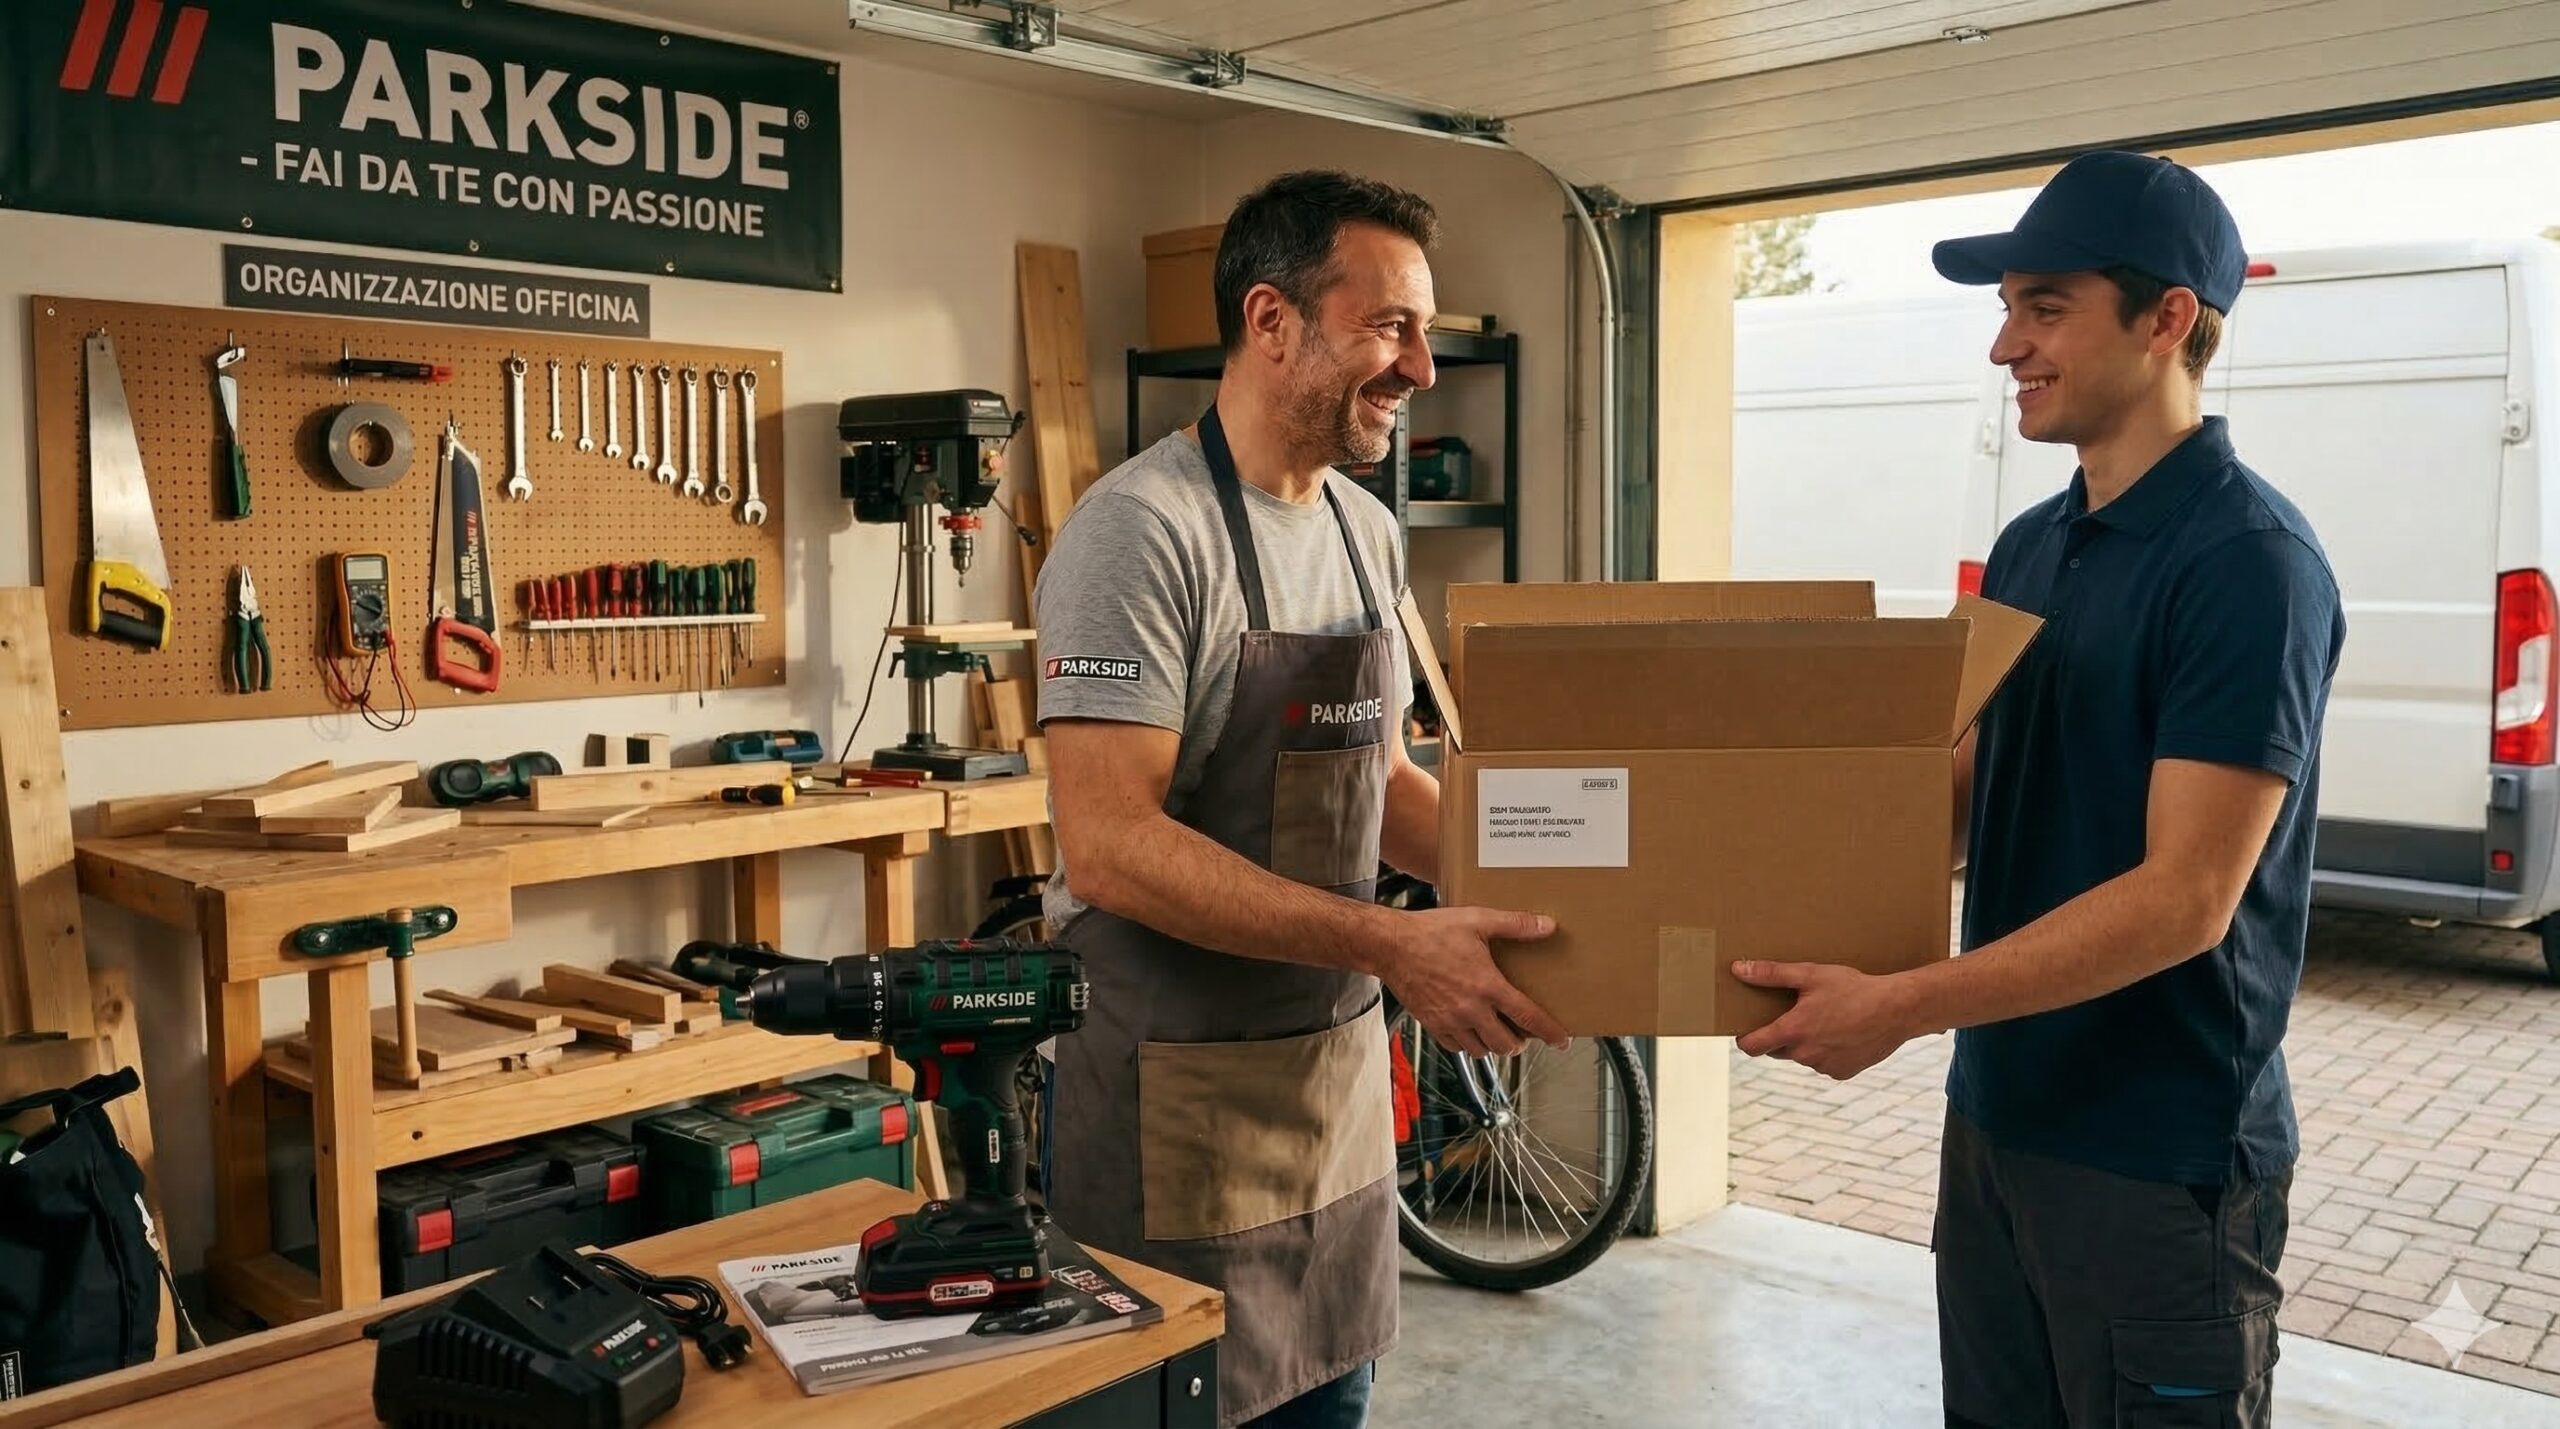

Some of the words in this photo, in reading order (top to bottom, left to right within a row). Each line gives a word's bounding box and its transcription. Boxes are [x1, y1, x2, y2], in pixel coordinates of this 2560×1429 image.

[275, 142, 343, 188] FAI
[359, 153, 419, 197] DA
[428, 163, 481, 204] TE
[493, 171, 575, 215] CON
[588, 183, 764, 237] PASSIONE
[240, 263, 508, 313] ORGANIZZAZIONE
[515, 287, 640, 324] OFFICINA
[1060, 659, 1139, 678] PARKSIDE
[1311, 697, 1383, 724] PARKSIDE
[953, 991, 1036, 1009] PARKSIDE
